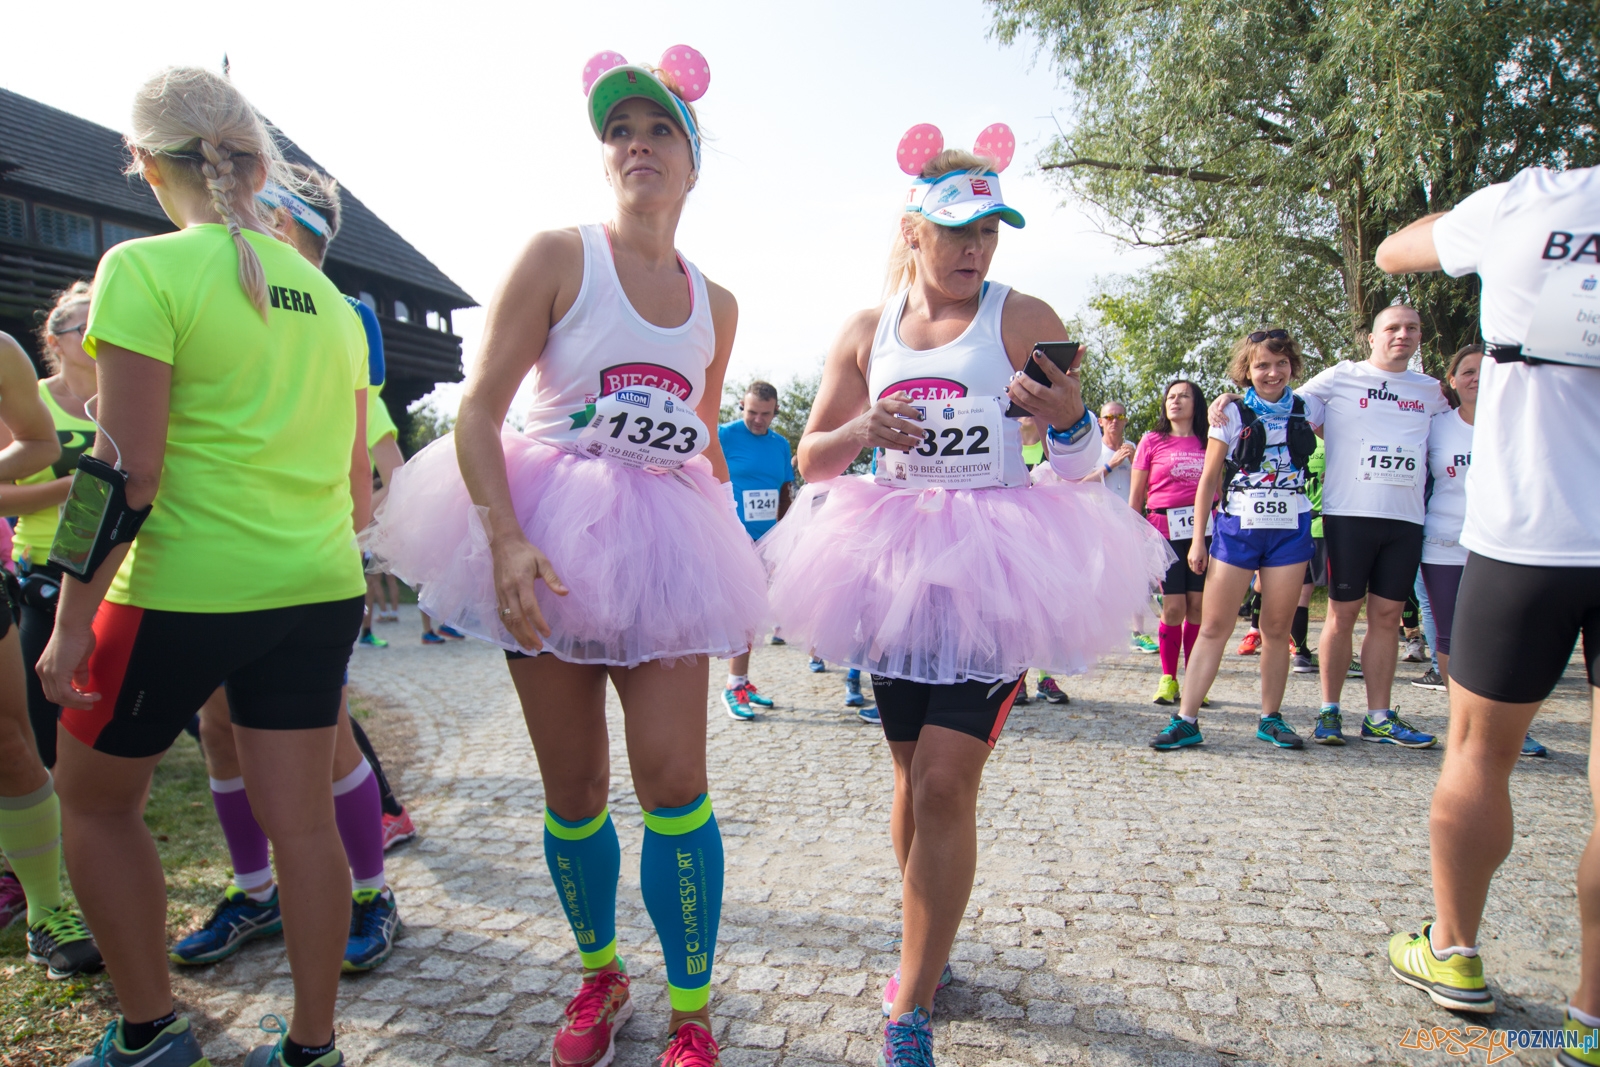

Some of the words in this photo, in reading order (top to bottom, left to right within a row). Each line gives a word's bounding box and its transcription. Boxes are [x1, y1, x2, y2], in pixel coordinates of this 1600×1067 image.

[608, 411, 698, 454] 1323
[902, 426, 990, 457] 322
[608, 446, 620, 455] 39
[621, 449, 643, 461] BIEG
[908, 464, 919, 473] 39
[920, 465, 942, 474] BIEG
[944, 462, 992, 474] LECHITÓW
[1367, 455, 1416, 471] 1576
[749, 499, 776, 510] 1241
[1253, 501, 1288, 514] 658
